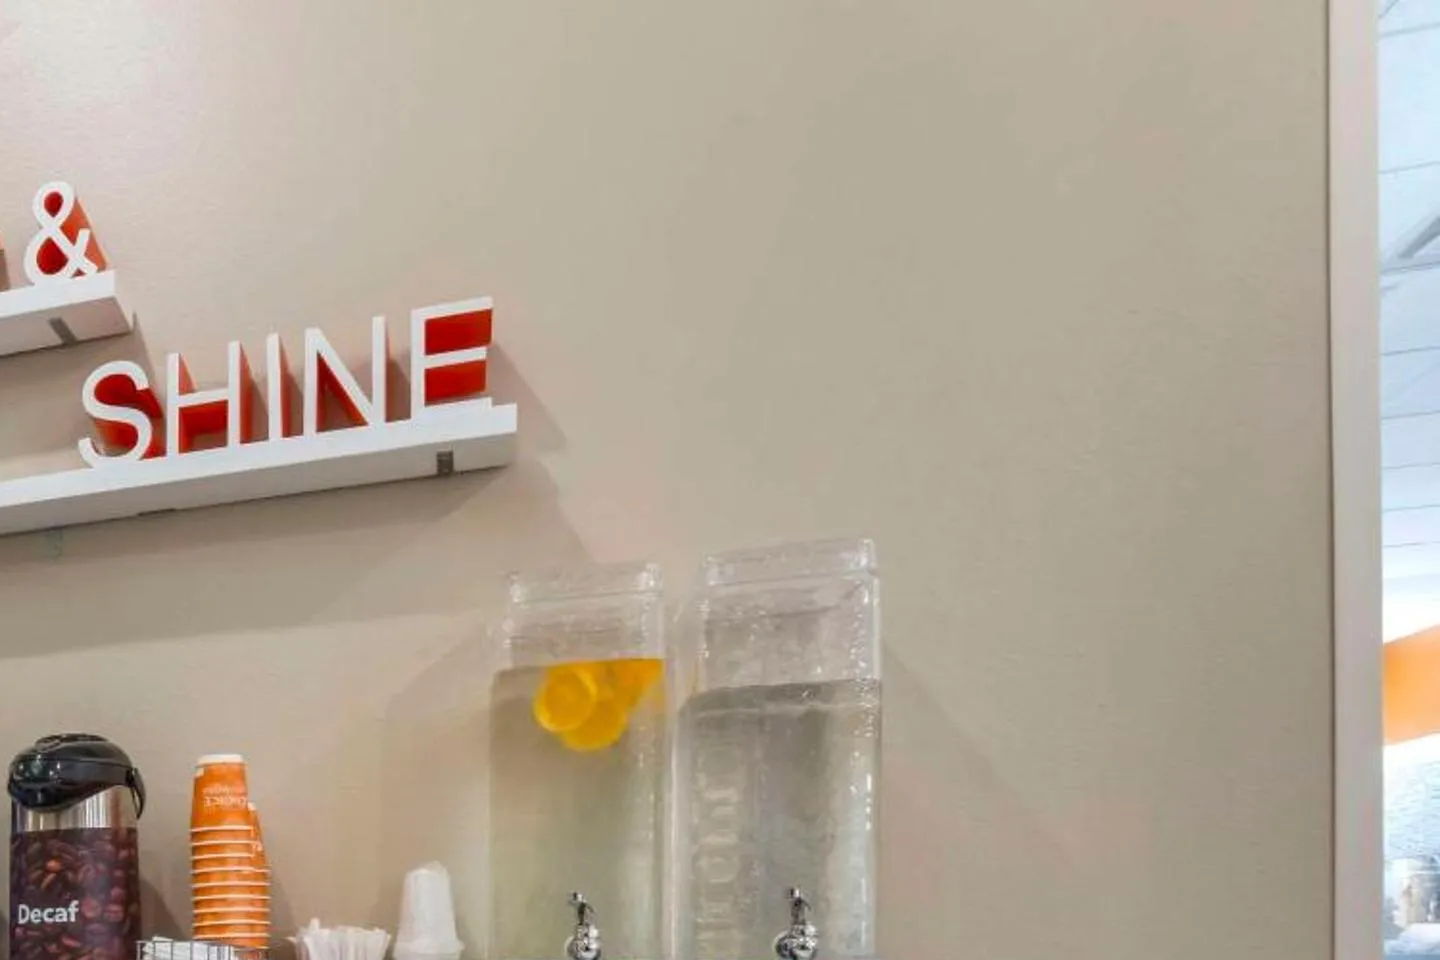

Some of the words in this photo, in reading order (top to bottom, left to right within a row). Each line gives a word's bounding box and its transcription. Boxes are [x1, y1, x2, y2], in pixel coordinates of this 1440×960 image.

[24, 180, 106, 286] &
[77, 296, 494, 469] SHINE
[18, 900, 80, 925] Decaf
